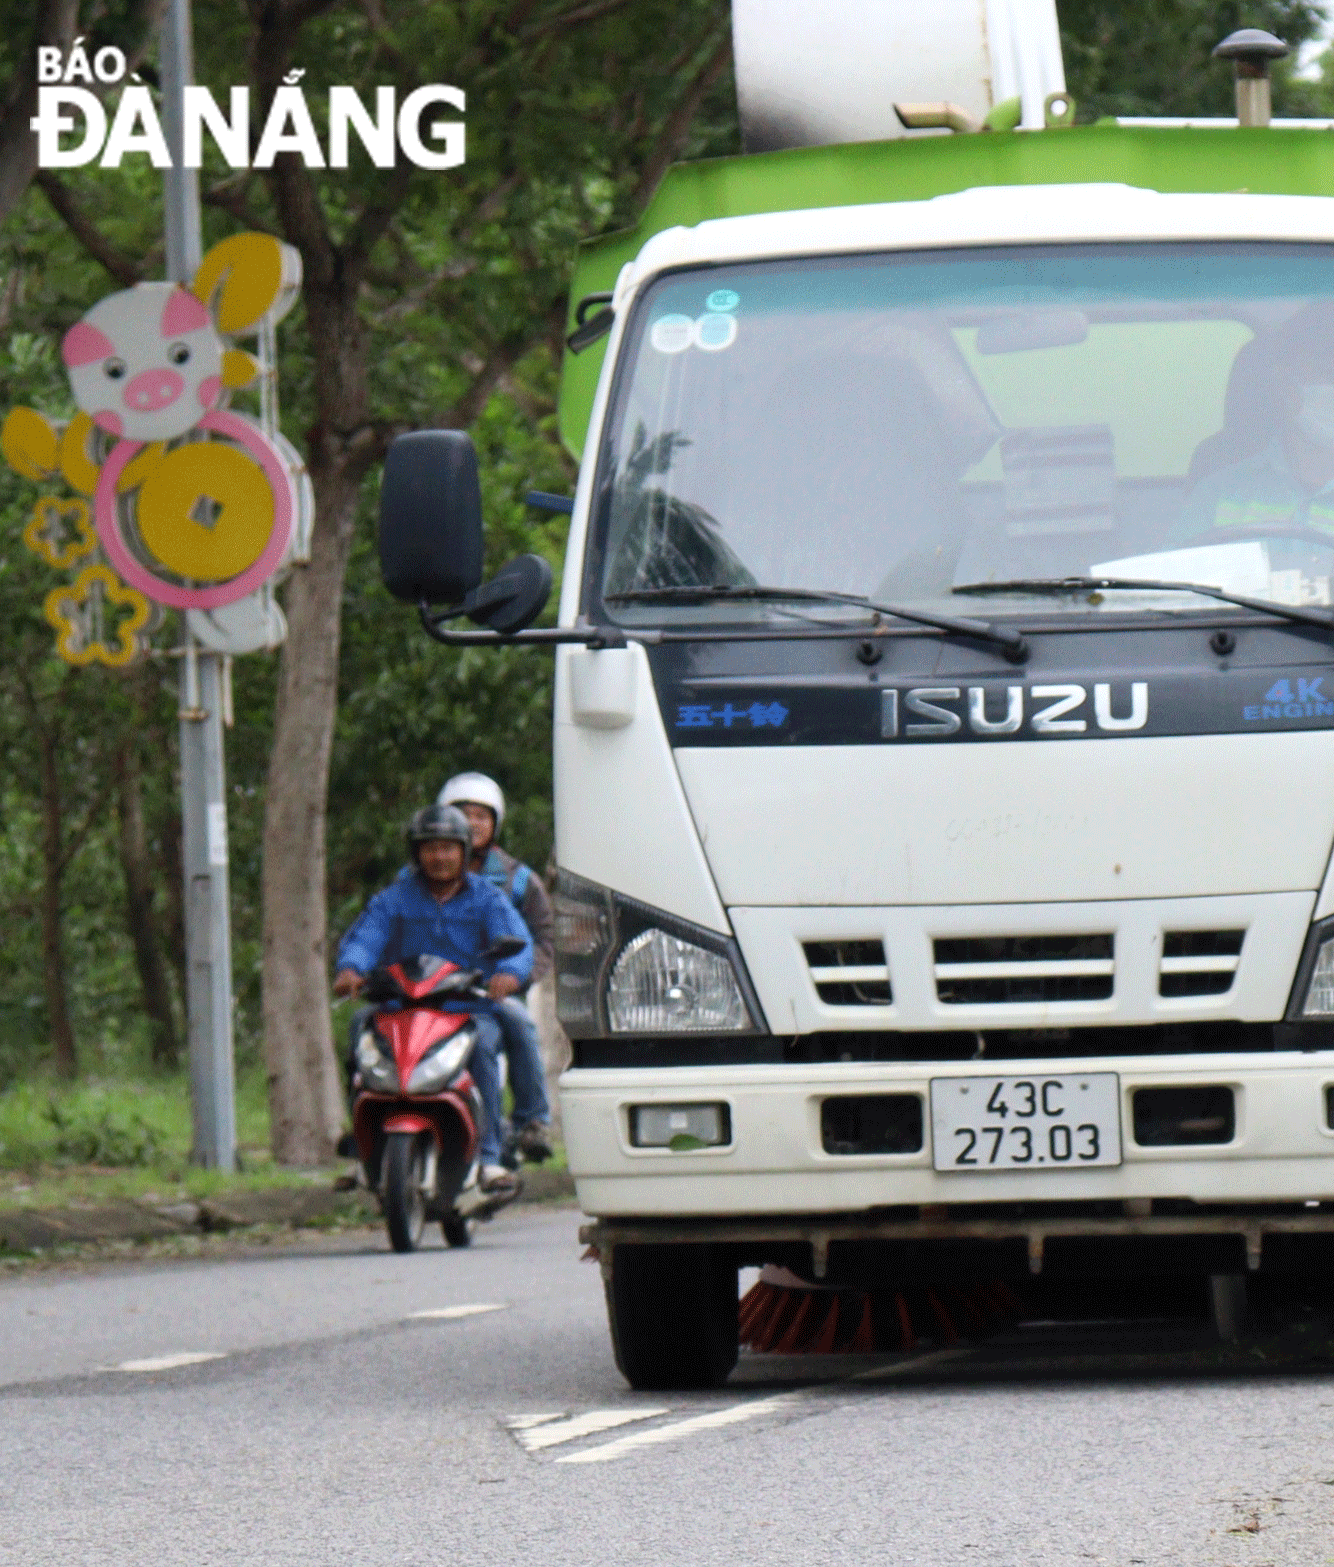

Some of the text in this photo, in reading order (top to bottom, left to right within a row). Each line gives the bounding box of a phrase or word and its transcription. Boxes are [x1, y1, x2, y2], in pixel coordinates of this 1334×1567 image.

[1265, 677, 1327, 703] 4K
[880, 682, 1149, 738] ISUZU
[986, 1080, 1065, 1118] 43C
[954, 1124, 1100, 1165] 273.03
